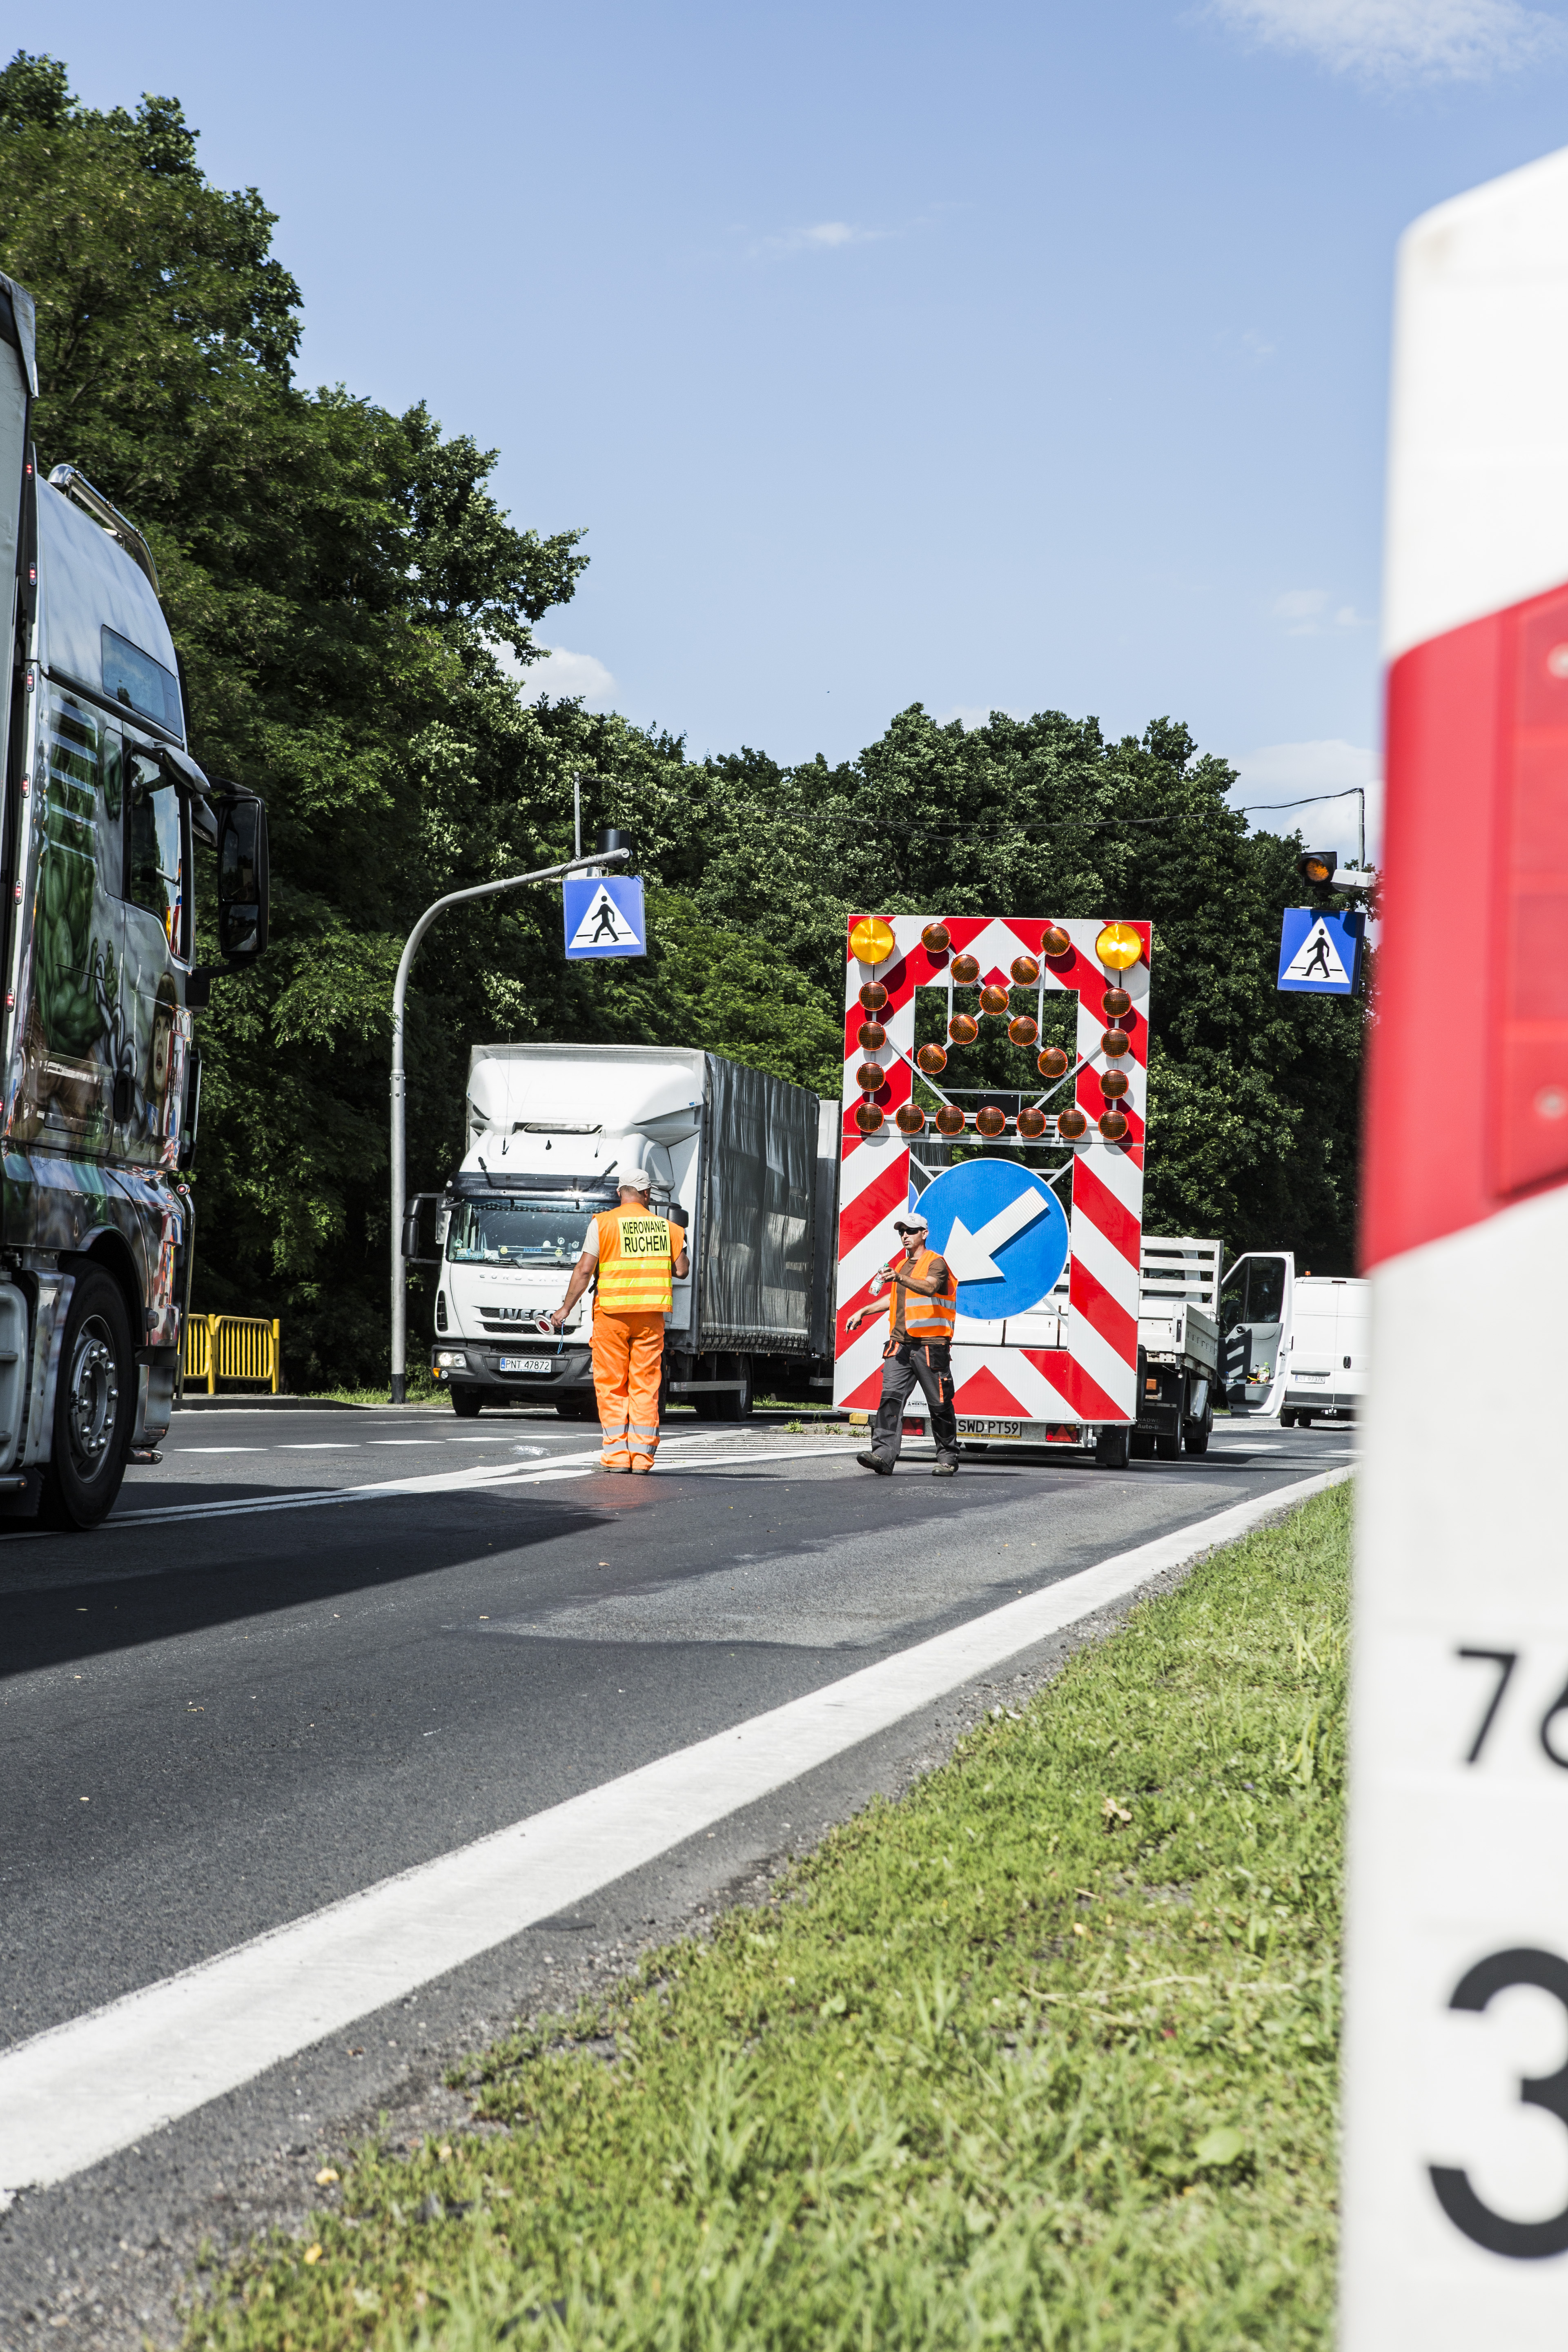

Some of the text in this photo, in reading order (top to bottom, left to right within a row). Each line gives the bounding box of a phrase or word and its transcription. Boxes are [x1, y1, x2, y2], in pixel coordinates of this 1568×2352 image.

[622, 1221, 666, 1234] KIEROWANIE
[624, 1235, 667, 1252] RUCHEM
[479, 1272, 570, 1282] EUROCARG
[506, 1360, 549, 1370] PNT 47872
[958, 1420, 1018, 1434] SWD PT59
[1428, 1947, 1568, 2258] 3
